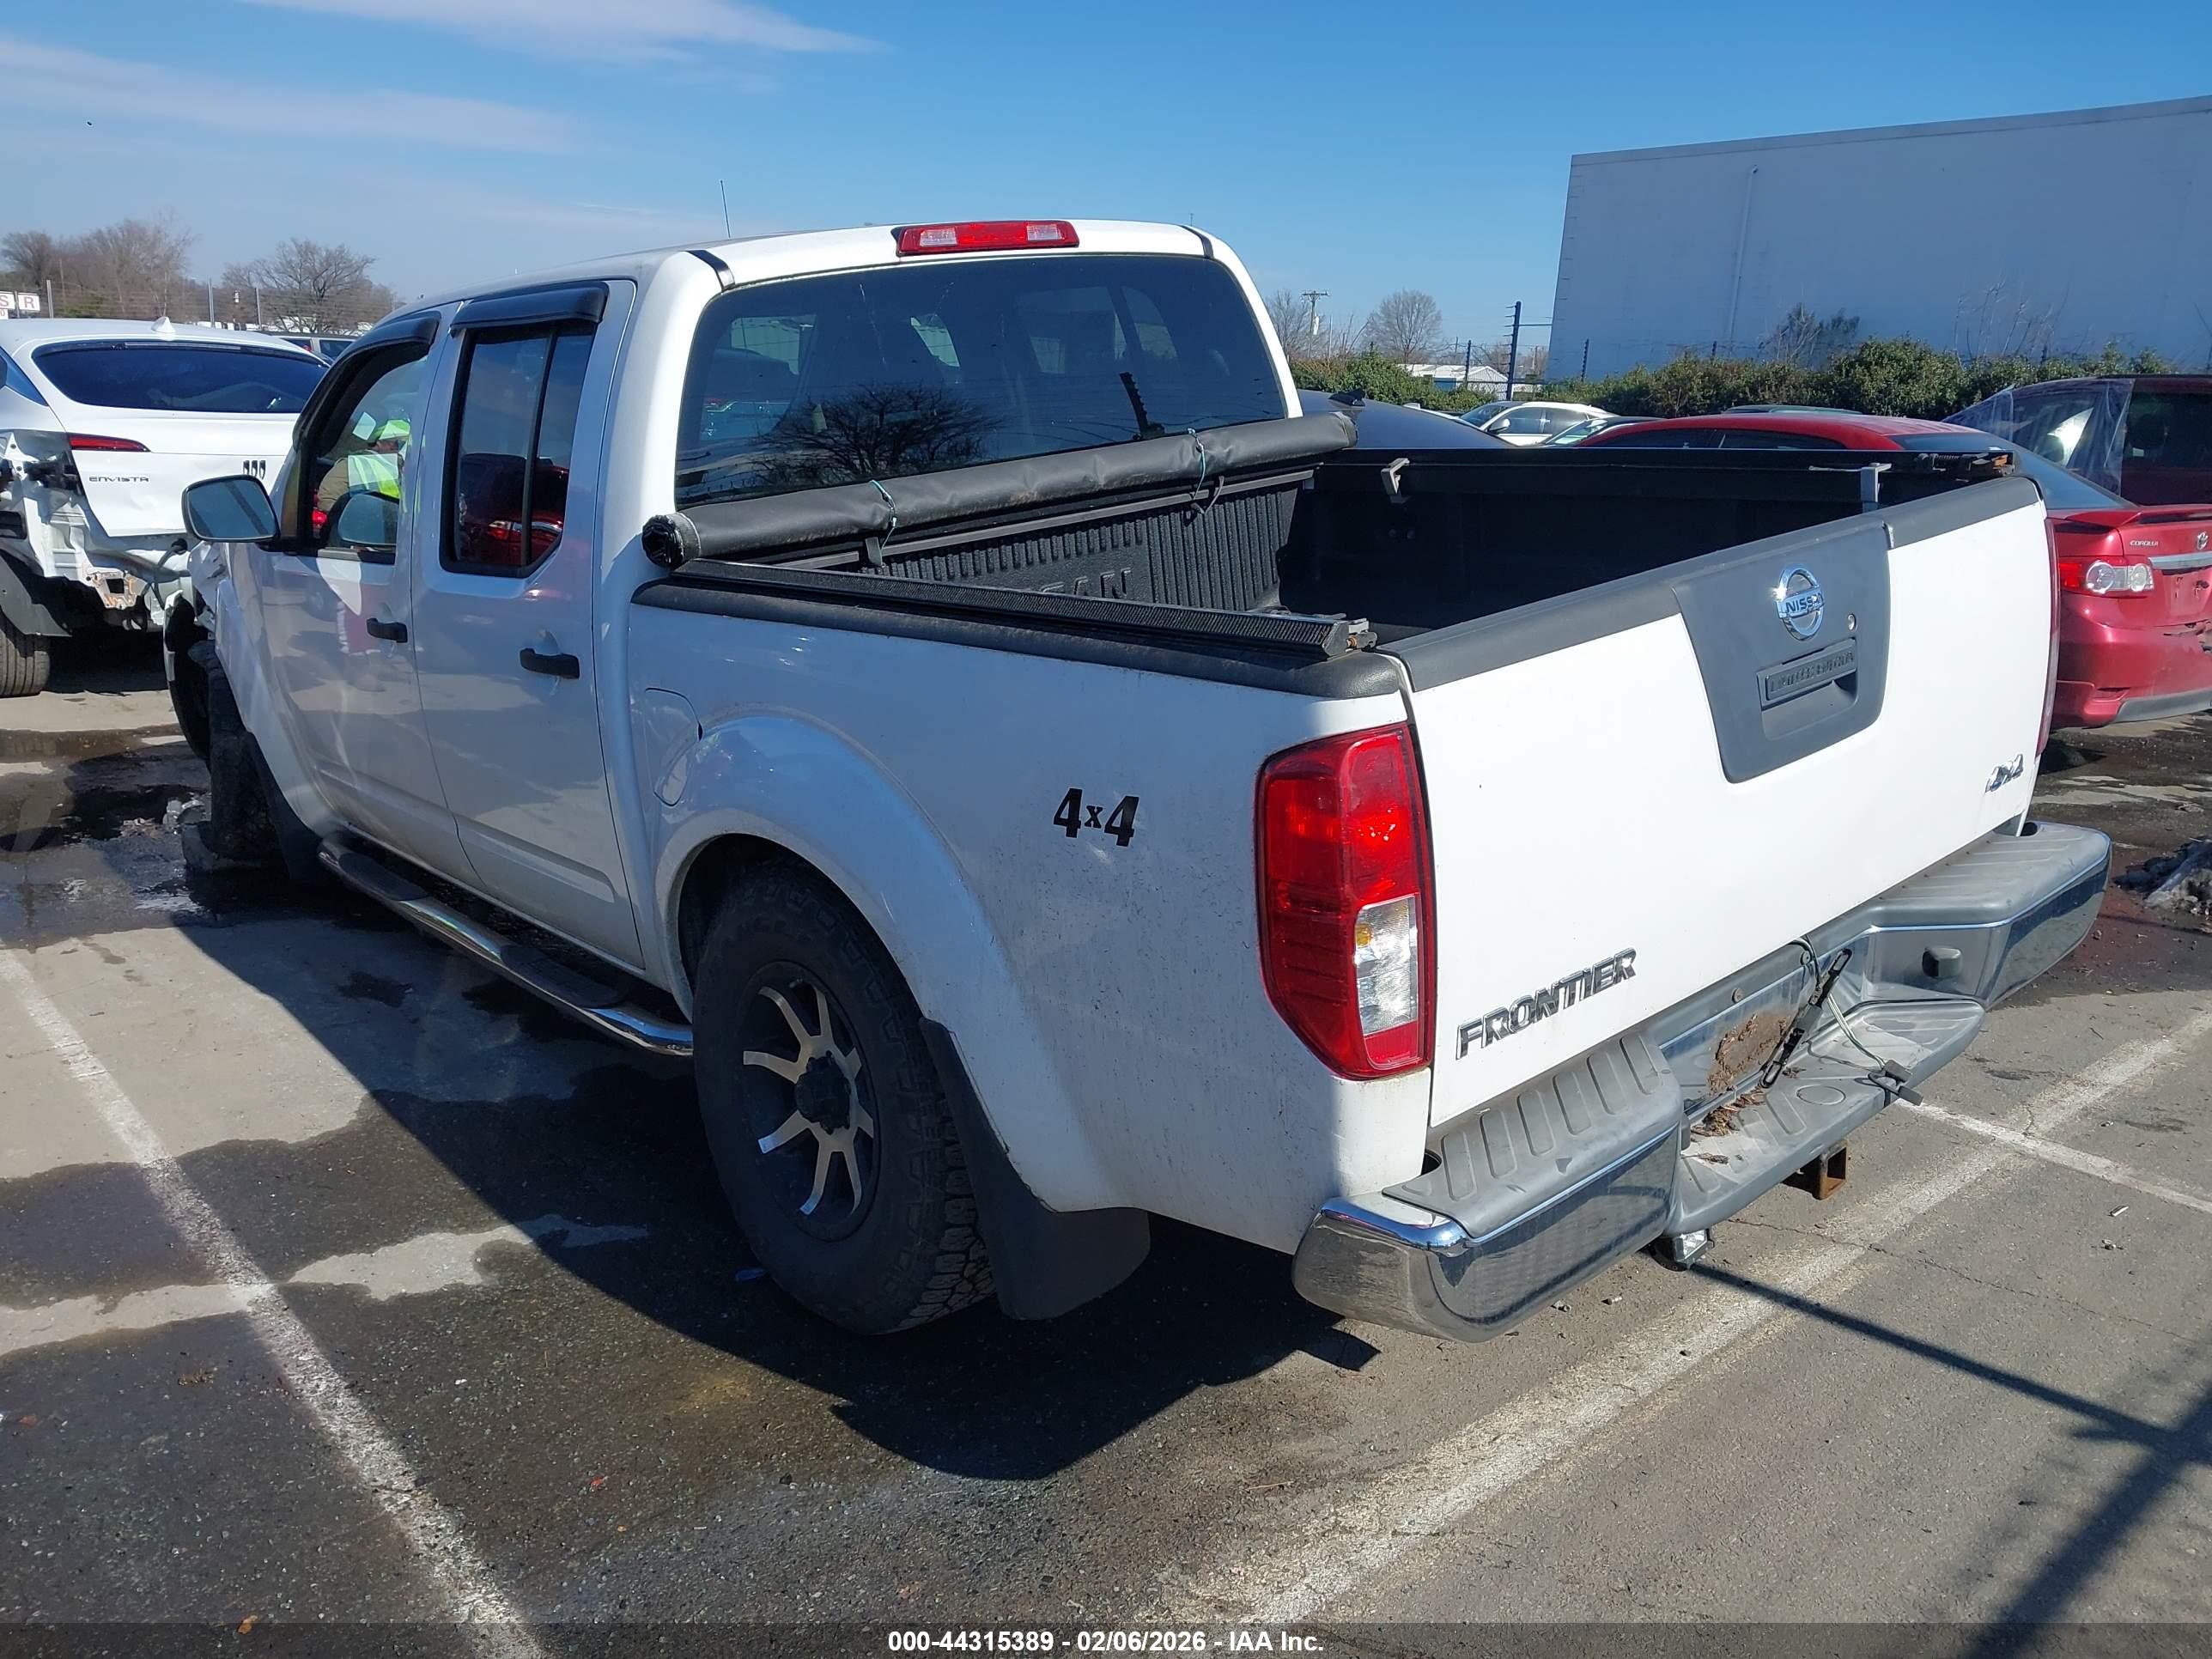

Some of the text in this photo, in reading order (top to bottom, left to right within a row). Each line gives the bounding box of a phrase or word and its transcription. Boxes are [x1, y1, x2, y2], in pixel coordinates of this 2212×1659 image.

[23, 296, 35, 309] R
[1053, 787, 1140, 848] 4x4
[1455, 946, 1637, 1060] FRONTIER
